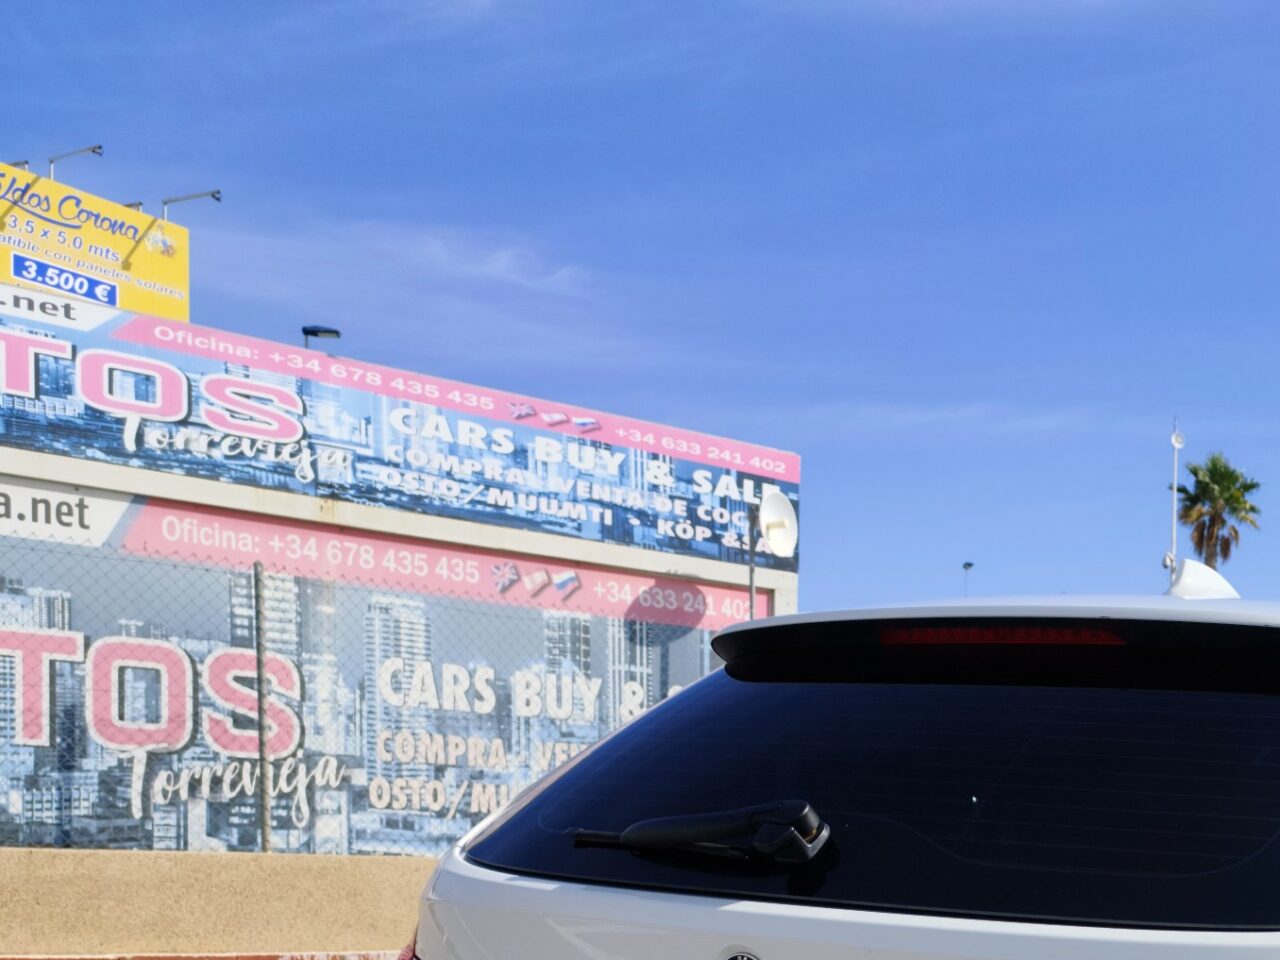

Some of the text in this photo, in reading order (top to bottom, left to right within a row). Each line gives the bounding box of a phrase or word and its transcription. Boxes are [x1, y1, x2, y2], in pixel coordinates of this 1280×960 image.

[58, 195, 140, 242] Corona
[22, 261, 112, 303] 3.500 €
[45, 249, 72, 264] con
[77, 259, 132, 283] paneles
[136, 278, 184, 300] solares
[154, 325, 495, 411] Oficina: +34 678 435 435
[112, 411, 354, 484] Torrevieja
[390, 407, 516, 455] CARS
[535, 435, 626, 477] BUY
[645, 459, 676, 489] &
[614, 427, 786, 474] +34 633 241 402
[384, 444, 527, 487] COMPRA
[546, 474, 644, 511] VENTA
[654, 496, 687, 517] DE
[161, 515, 480, 584] Oficina: +34 678 435 435
[657, 518, 712, 543] KÖP
[721, 531, 742, 550] &
[593, 579, 634, 604] +34
[638, 586, 677, 610] 633
[681, 591, 717, 617] 241
[379, 657, 646, 722] CARS BUY &
[376, 729, 508, 770] COMPRA
